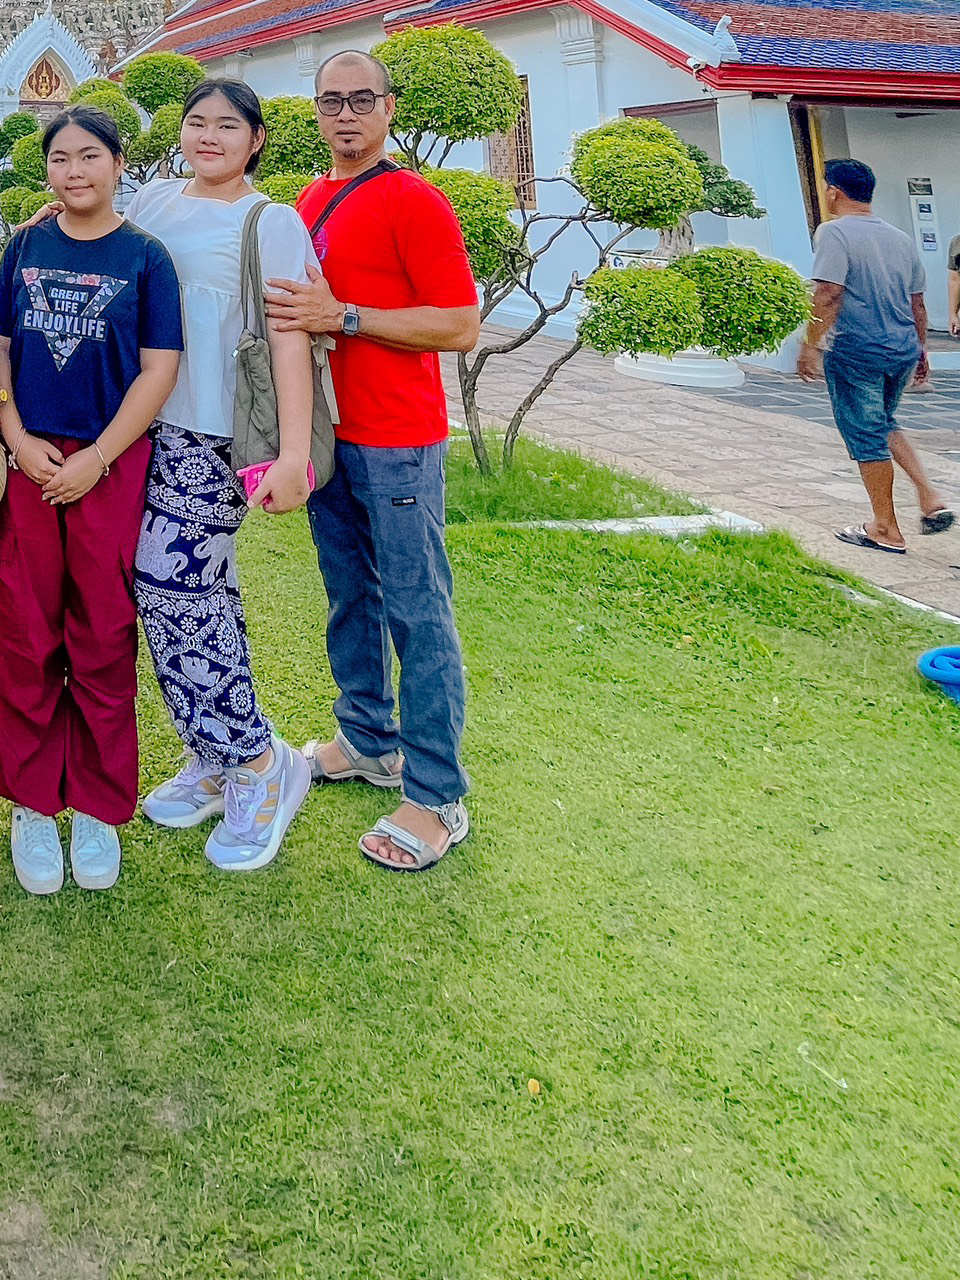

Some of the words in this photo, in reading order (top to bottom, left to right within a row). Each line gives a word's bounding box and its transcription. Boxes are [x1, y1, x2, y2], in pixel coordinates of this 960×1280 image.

[50, 287, 87, 302] GREAT
[54, 301, 79, 314] LIFE
[23, 309, 106, 338] ENJOYLIFE
